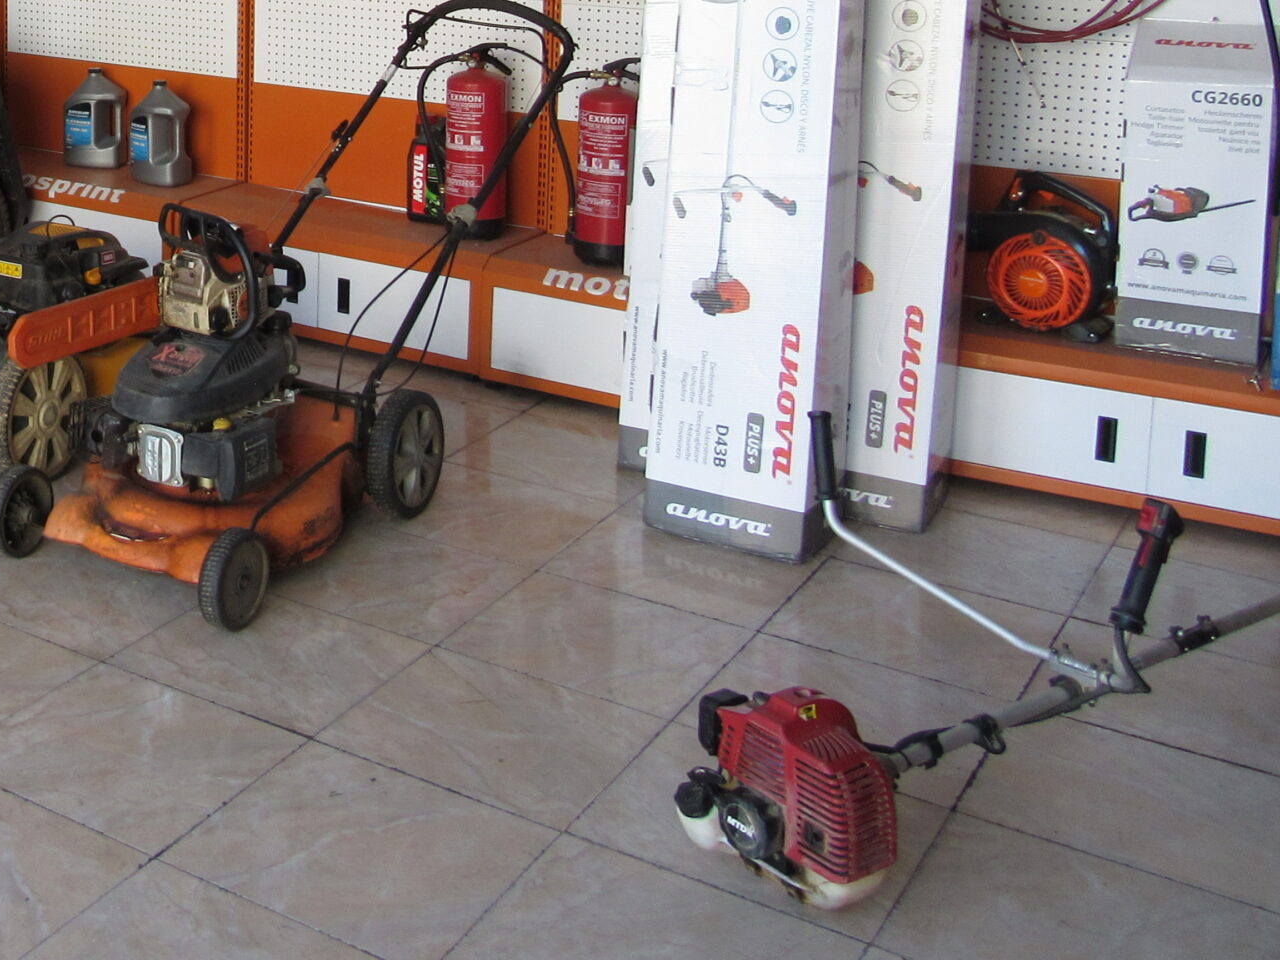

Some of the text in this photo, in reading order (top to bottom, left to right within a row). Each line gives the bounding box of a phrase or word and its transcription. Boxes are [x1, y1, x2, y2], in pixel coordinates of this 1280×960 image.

[803, 15, 815, 52] CABEZAL
[1154, 38, 1255, 51] anova
[798, 89, 809, 116] DISCO
[1191, 89, 1263, 107] CG2660
[22, 174, 127, 204] osprint
[412, 153, 424, 203] MOTUL
[542, 267, 630, 301] mot
[1132, 317, 1237, 340] anova
[894, 304, 924, 454] anova
[655, 348, 669, 454] www.anovamaquinaria.com
[772, 323, 801, 480] anova
[869, 399, 883, 440] PLUS+
[712, 424, 729, 468] D43B
[746, 422, 763, 466] PLUS+
[666, 502, 771, 537] anova
